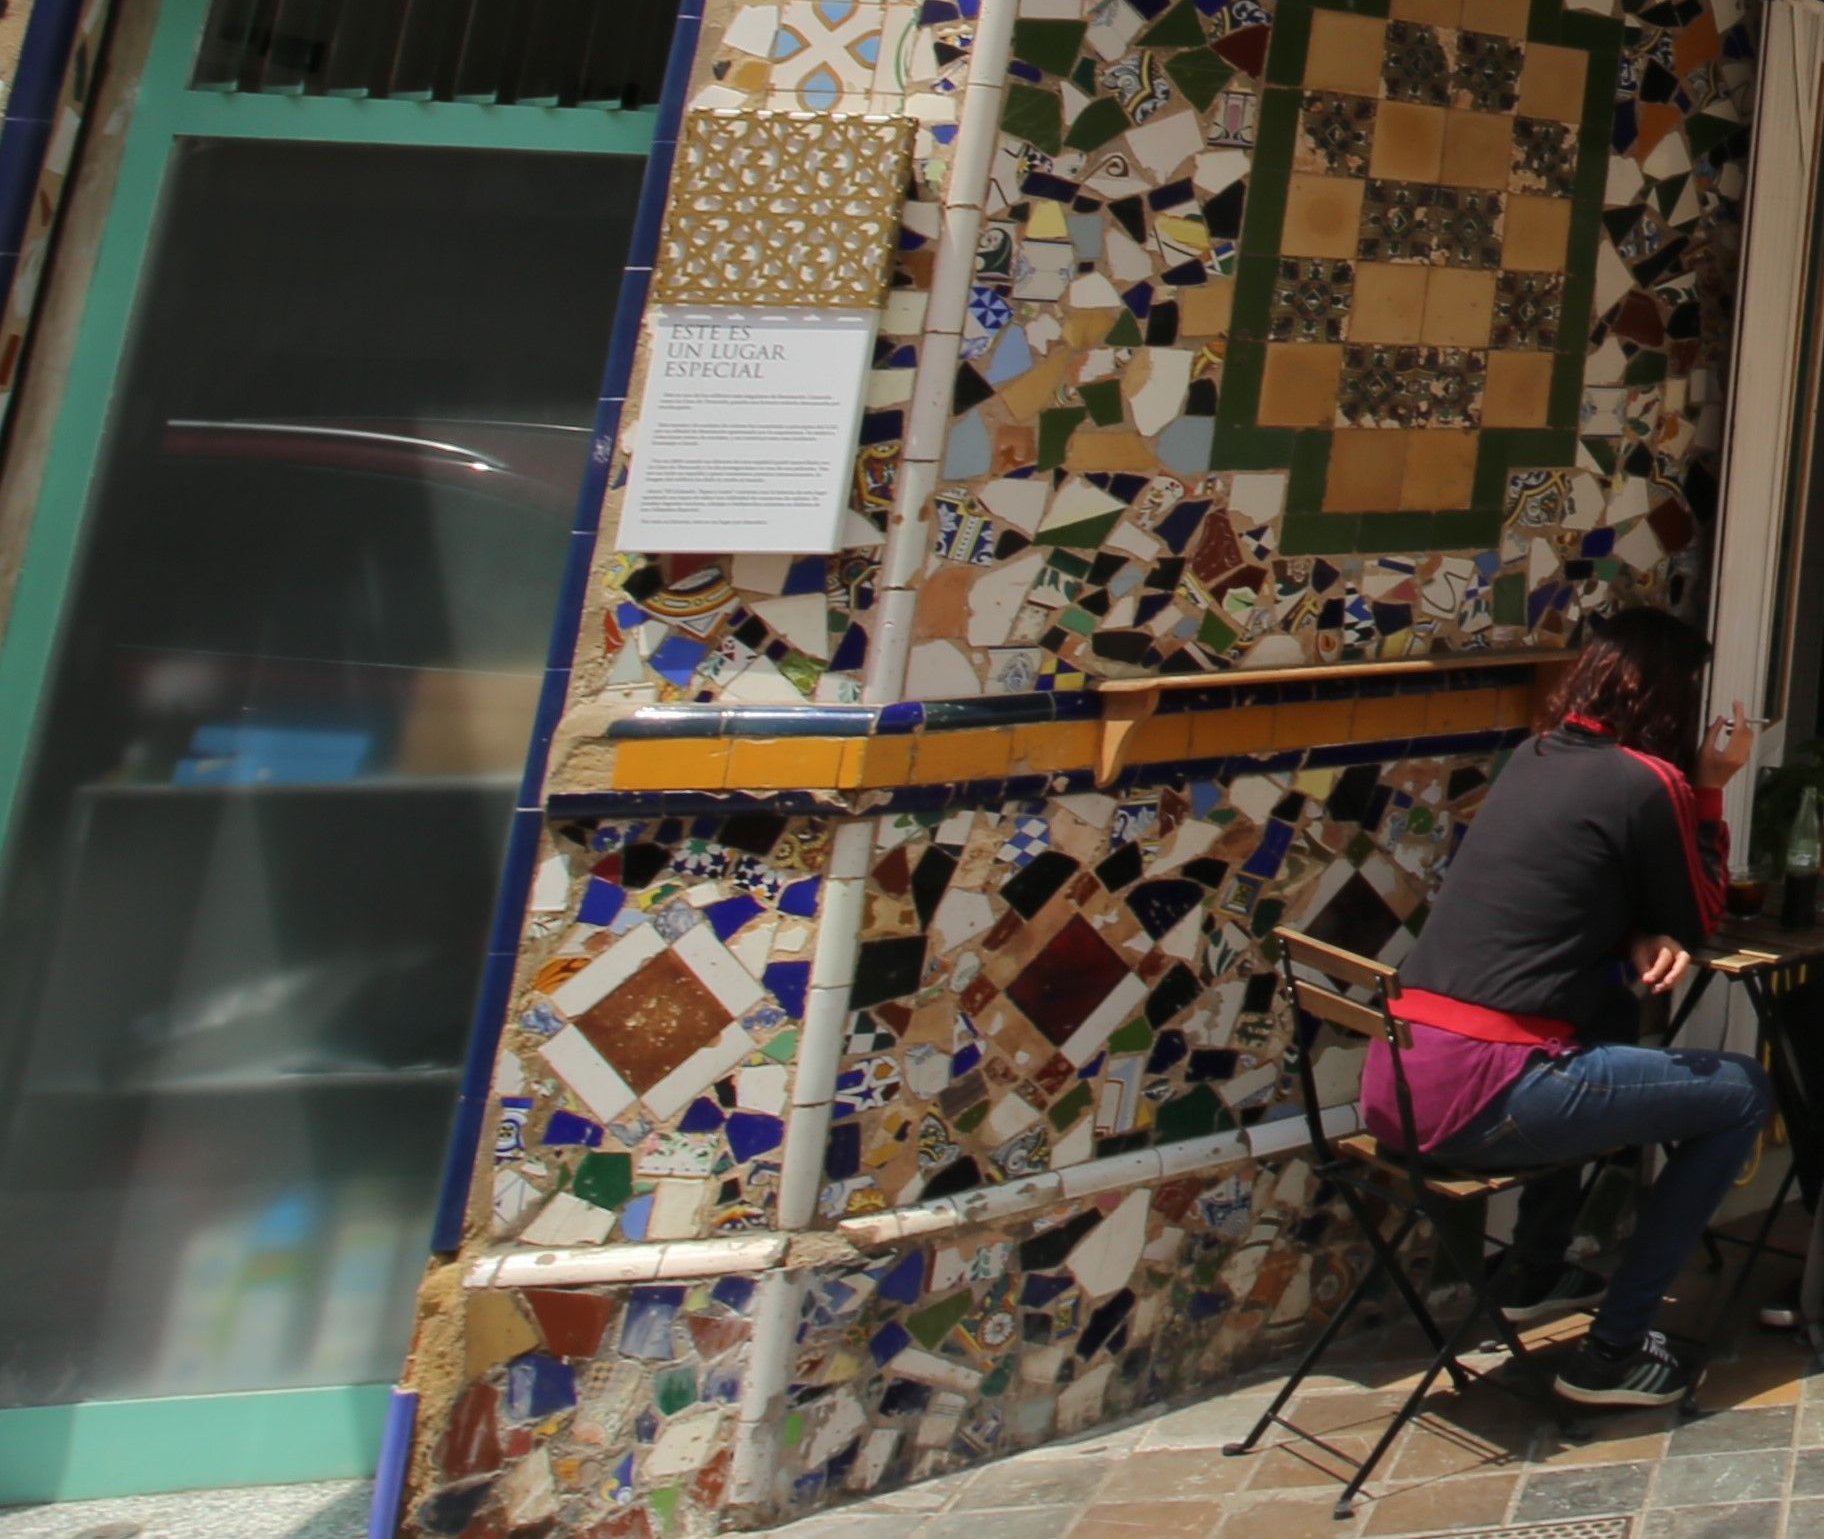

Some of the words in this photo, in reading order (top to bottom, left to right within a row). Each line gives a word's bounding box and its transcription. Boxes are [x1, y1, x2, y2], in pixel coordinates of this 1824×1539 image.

[671, 324, 721, 341] ESTE
[729, 325, 752, 341] ES
[667, 342, 704, 359] UN
[711, 343, 787, 360] LUGAR
[664, 361, 764, 379] ESPECIAL
